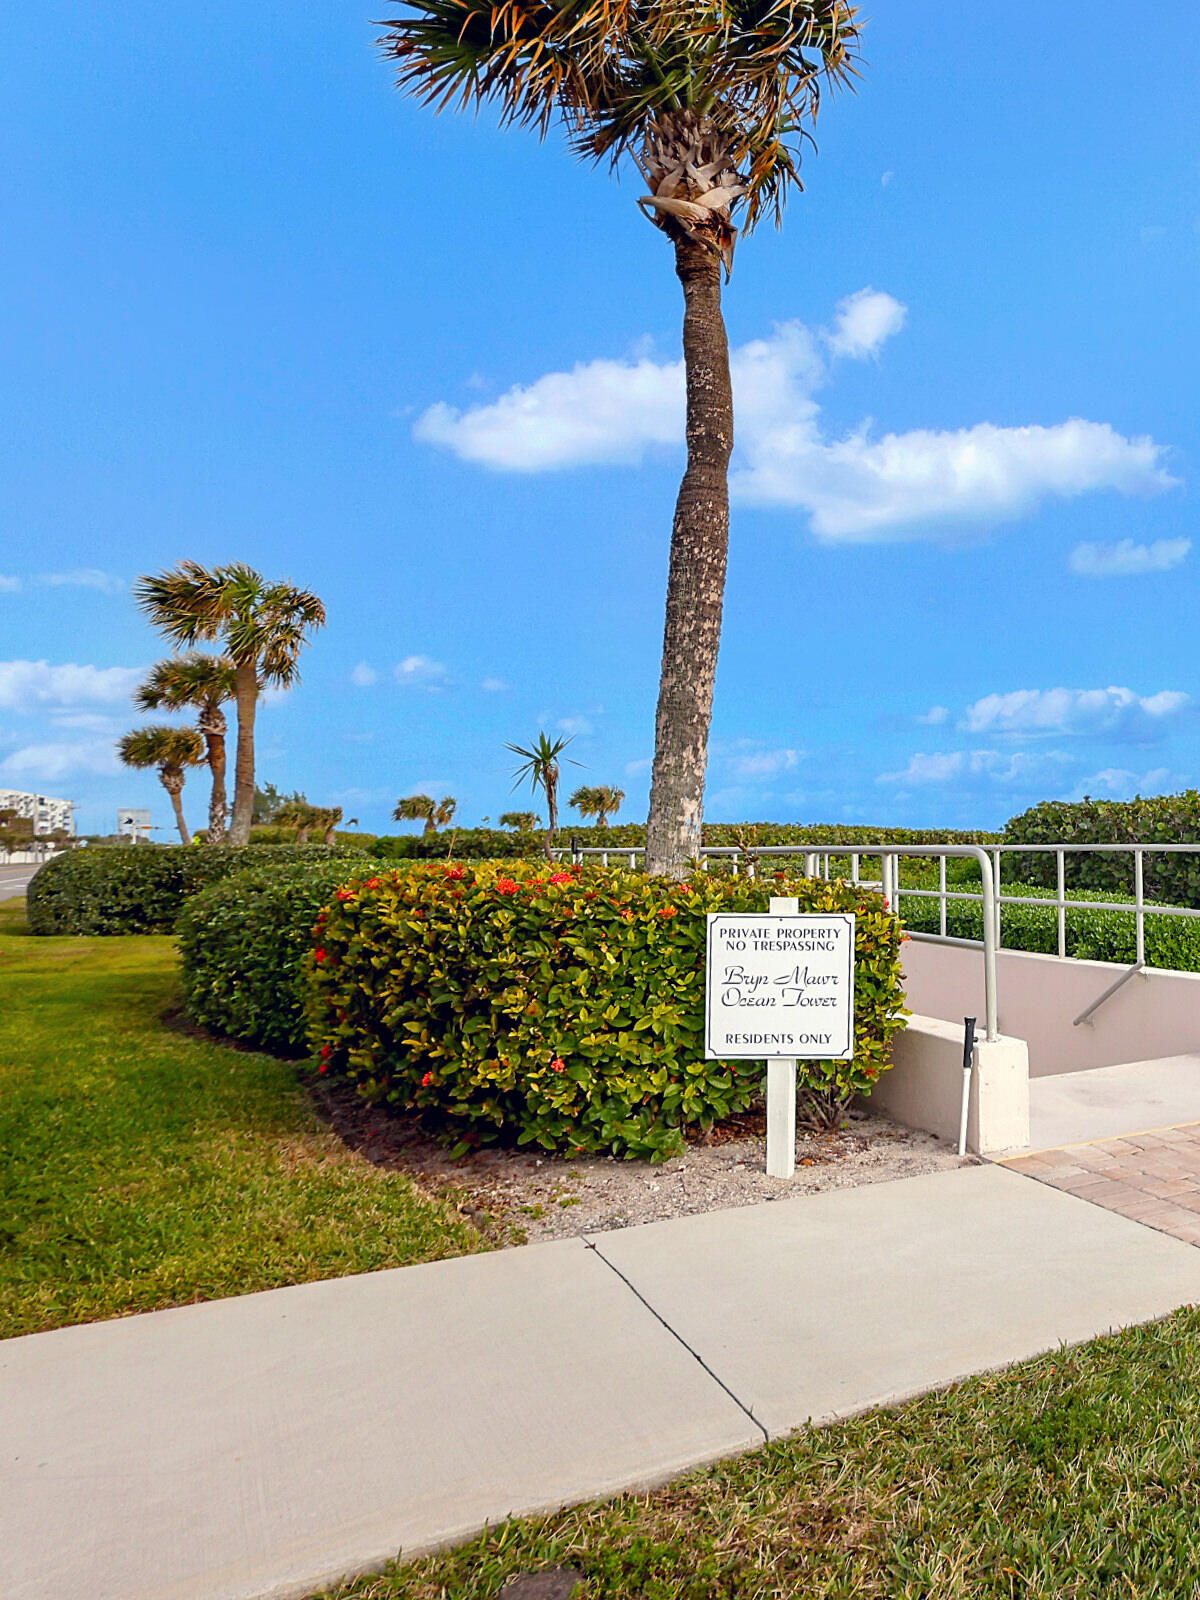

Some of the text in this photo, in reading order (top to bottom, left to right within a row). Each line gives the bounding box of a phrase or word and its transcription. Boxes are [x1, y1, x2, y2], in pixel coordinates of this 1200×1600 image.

[719, 928, 841, 939] PRIVATE PROPERTY
[726, 941, 835, 951] NO TRESPASSING
[721, 965, 839, 993] Bryn Mawr
[721, 987, 837, 1007] Ocean Tower
[725, 1033, 832, 1044] RESIDENTS ONLY
